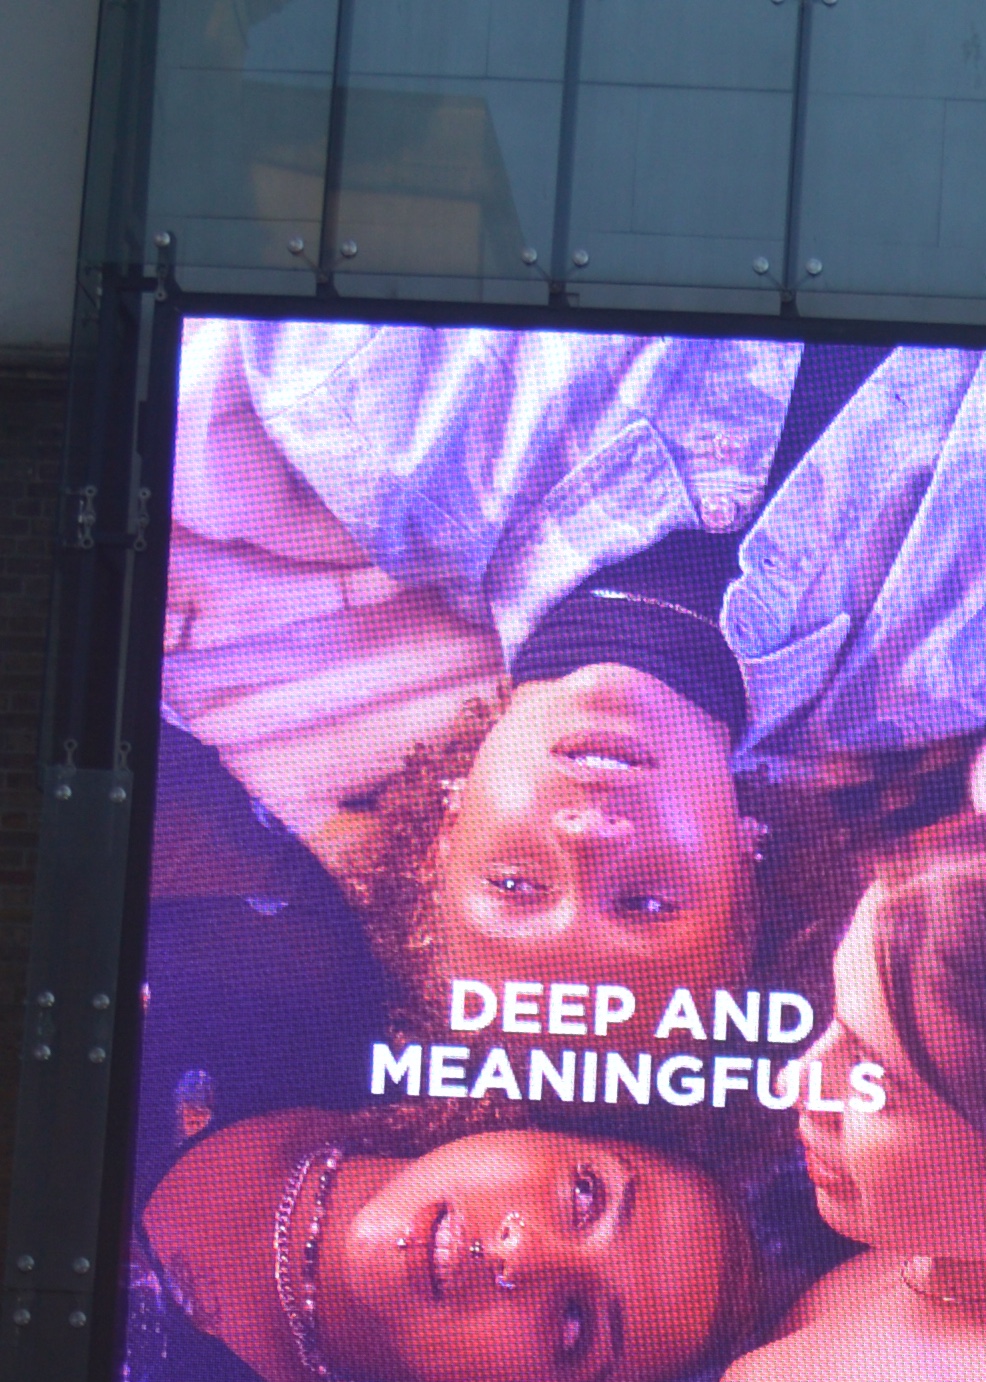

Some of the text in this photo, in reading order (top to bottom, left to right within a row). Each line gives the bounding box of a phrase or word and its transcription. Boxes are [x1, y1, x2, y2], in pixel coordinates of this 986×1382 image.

[449, 979, 814, 1044] DEEP AND
[371, 1042, 887, 1113] MEANINGFULS
